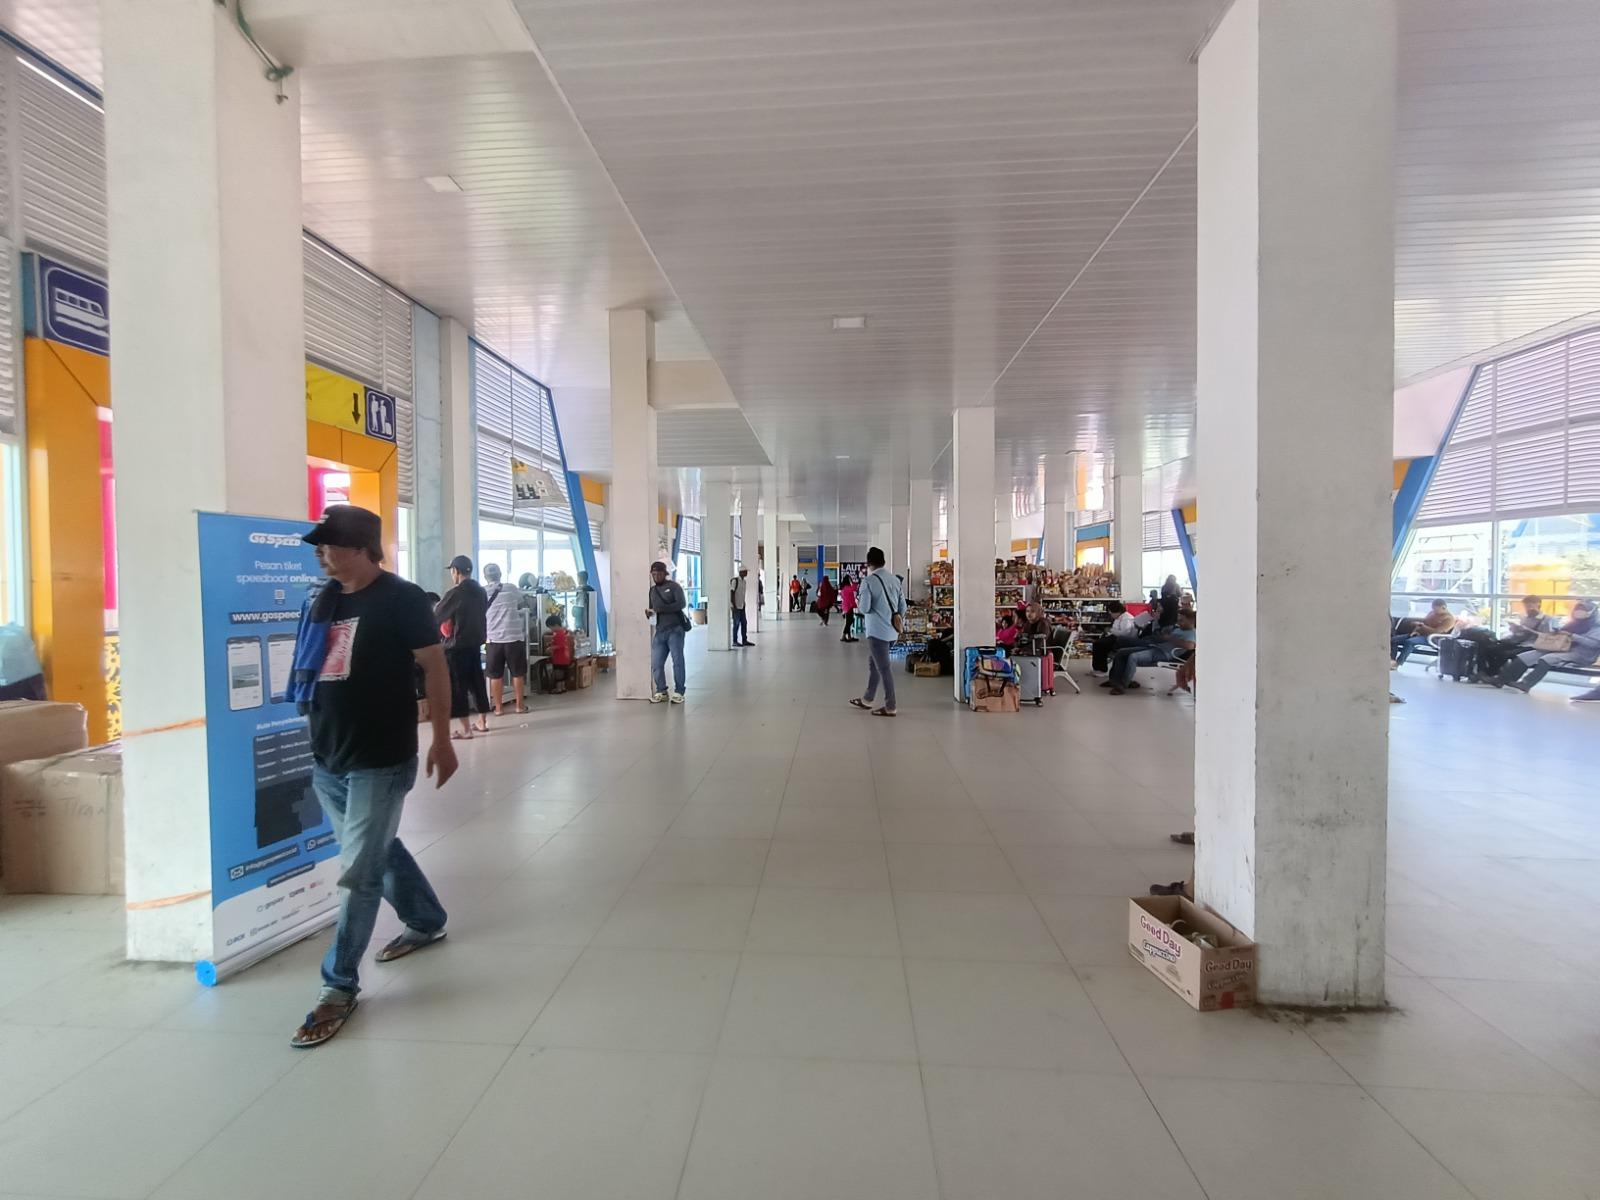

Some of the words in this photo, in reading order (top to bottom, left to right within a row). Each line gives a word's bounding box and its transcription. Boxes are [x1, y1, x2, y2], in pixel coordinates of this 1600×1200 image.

[254, 560, 283, 570] Pesan
[283, 561, 302, 570] tiket
[236, 574, 288, 585] speedboat
[289, 573, 318, 583] online
[1140, 915, 1162, 940] Good
[1162, 931, 1182, 958] Day
[1205, 960, 1231, 973] Good
[1232, 959, 1252, 970] Day
